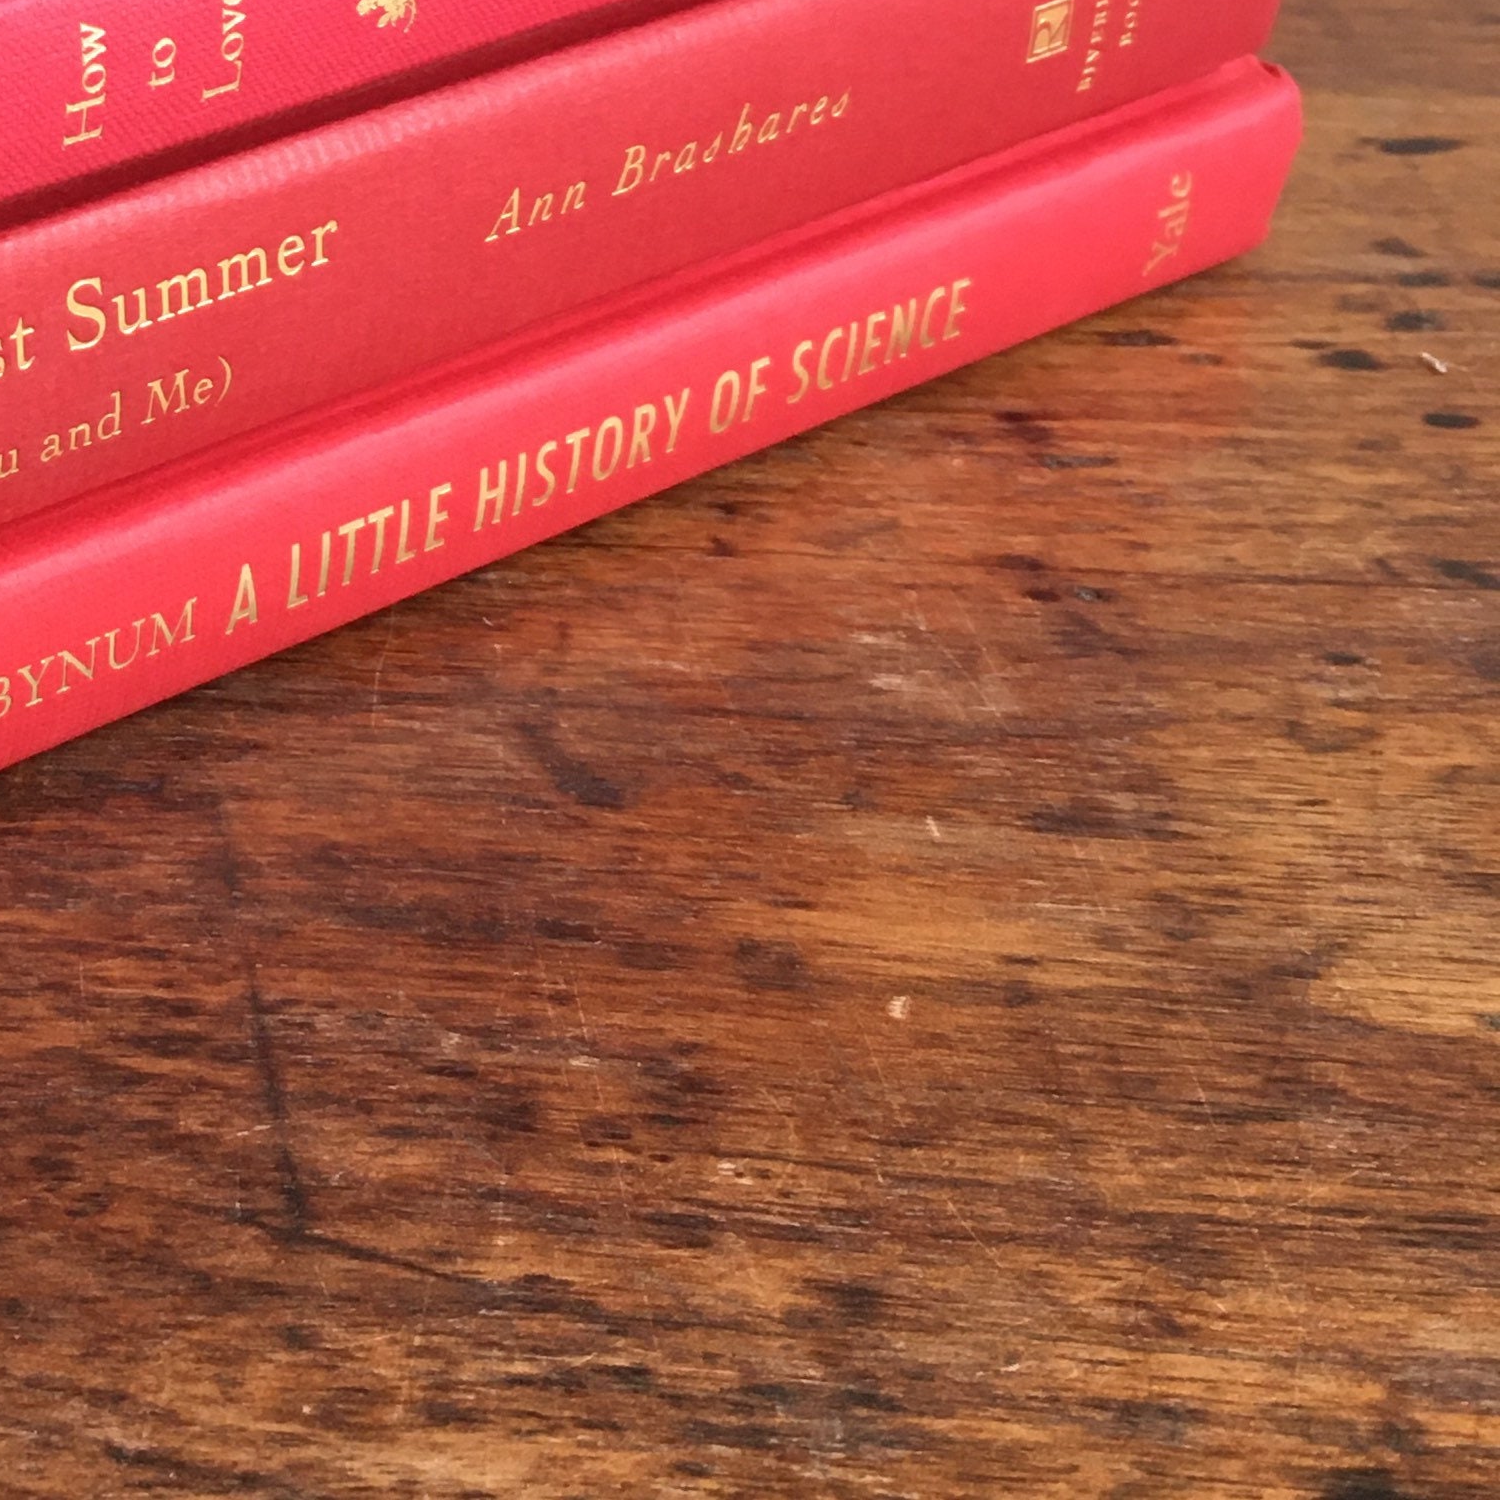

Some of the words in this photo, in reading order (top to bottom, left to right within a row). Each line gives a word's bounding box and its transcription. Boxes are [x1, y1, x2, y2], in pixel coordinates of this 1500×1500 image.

[62, 21, 107, 150] How
[147, 37, 177, 90] to
[484, 179, 588, 243] Ann
[611, 87, 852, 197] Brashares
[1141, 170, 1193, 277] Yale
[64, 219, 338, 352] Summer
[40, 392, 123, 463] and
[140, 355, 234, 426] Me)
[225, 562, 259, 635] A
[286, 482, 452, 610] LITTLE
[473, 387, 690, 532] HISTORY
[708, 357, 773, 434] OF
[784, 277, 973, 405] SCIENCE
